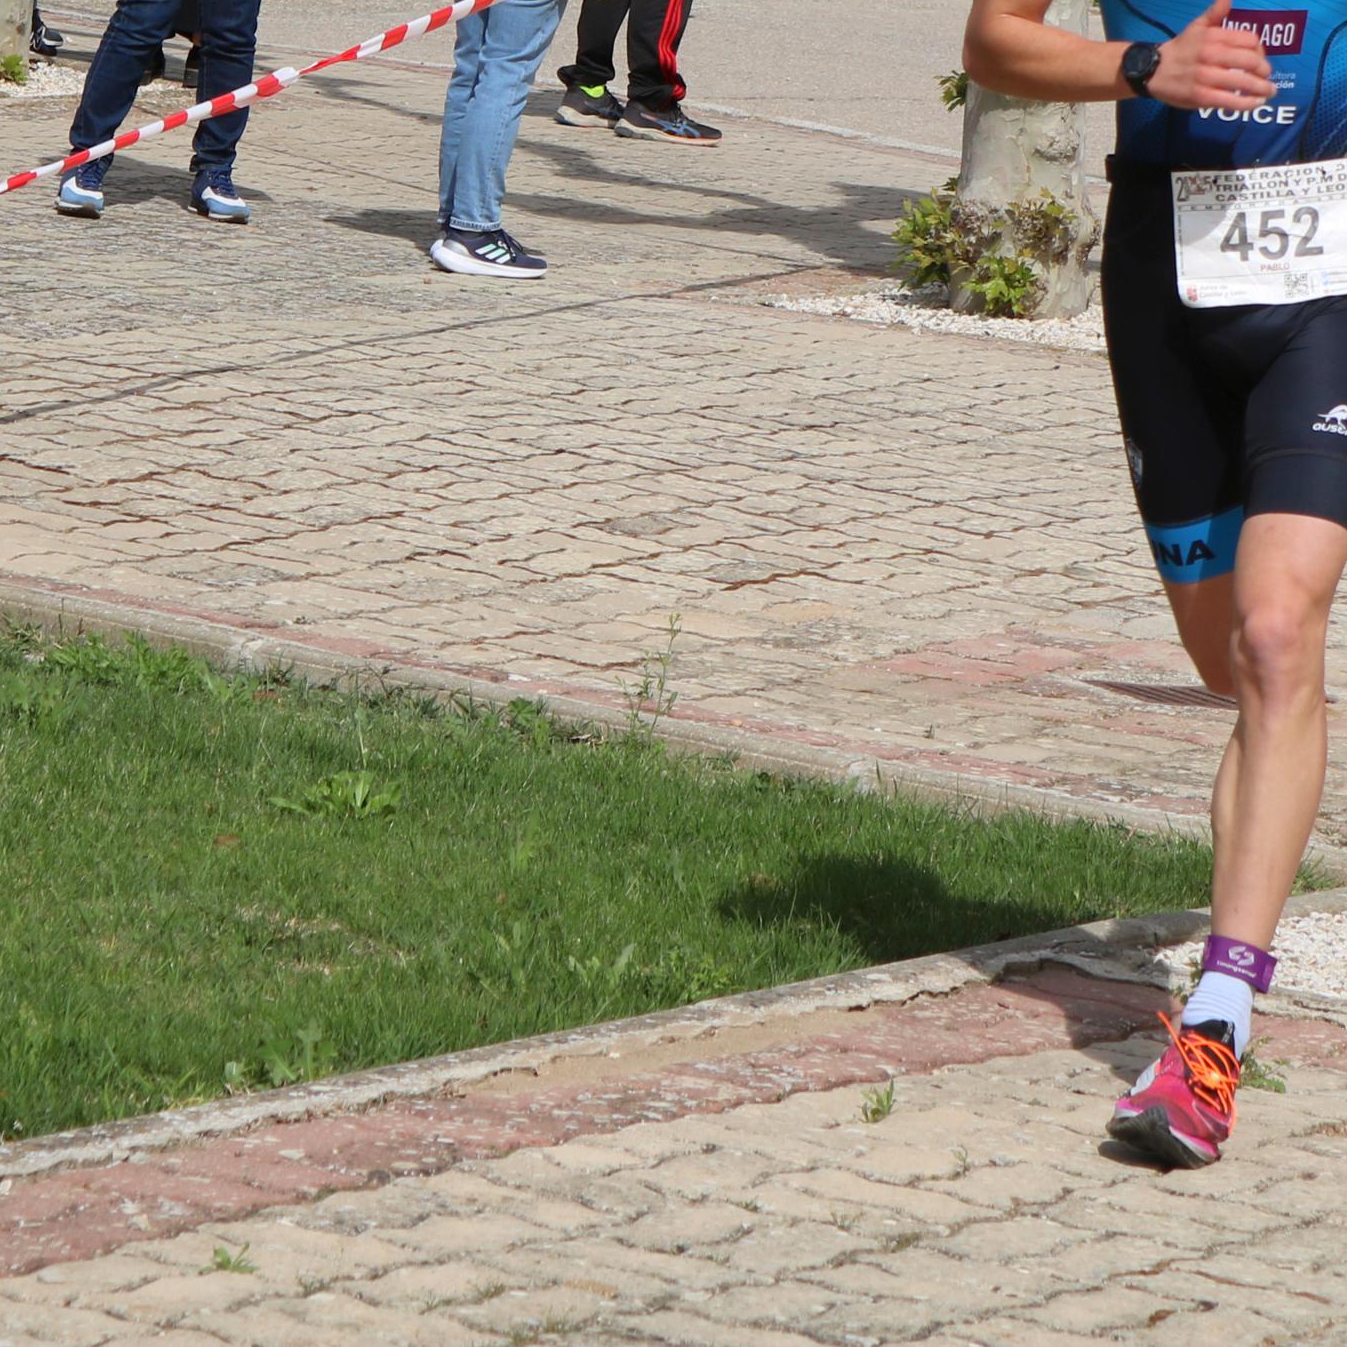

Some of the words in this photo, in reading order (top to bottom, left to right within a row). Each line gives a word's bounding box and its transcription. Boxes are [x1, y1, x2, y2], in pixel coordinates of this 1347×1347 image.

[1214, 166, 1325, 183] FEDERACION
[1216, 179, 1289, 192] TRIATLON
[1215, 189, 1296, 202] CASTILLA
[1302, 187, 1311, 196] Y
[1220, 206, 1324, 262] 452
[1260, 263, 1290, 272] PABLO
[1152, 538, 1216, 566] NA
